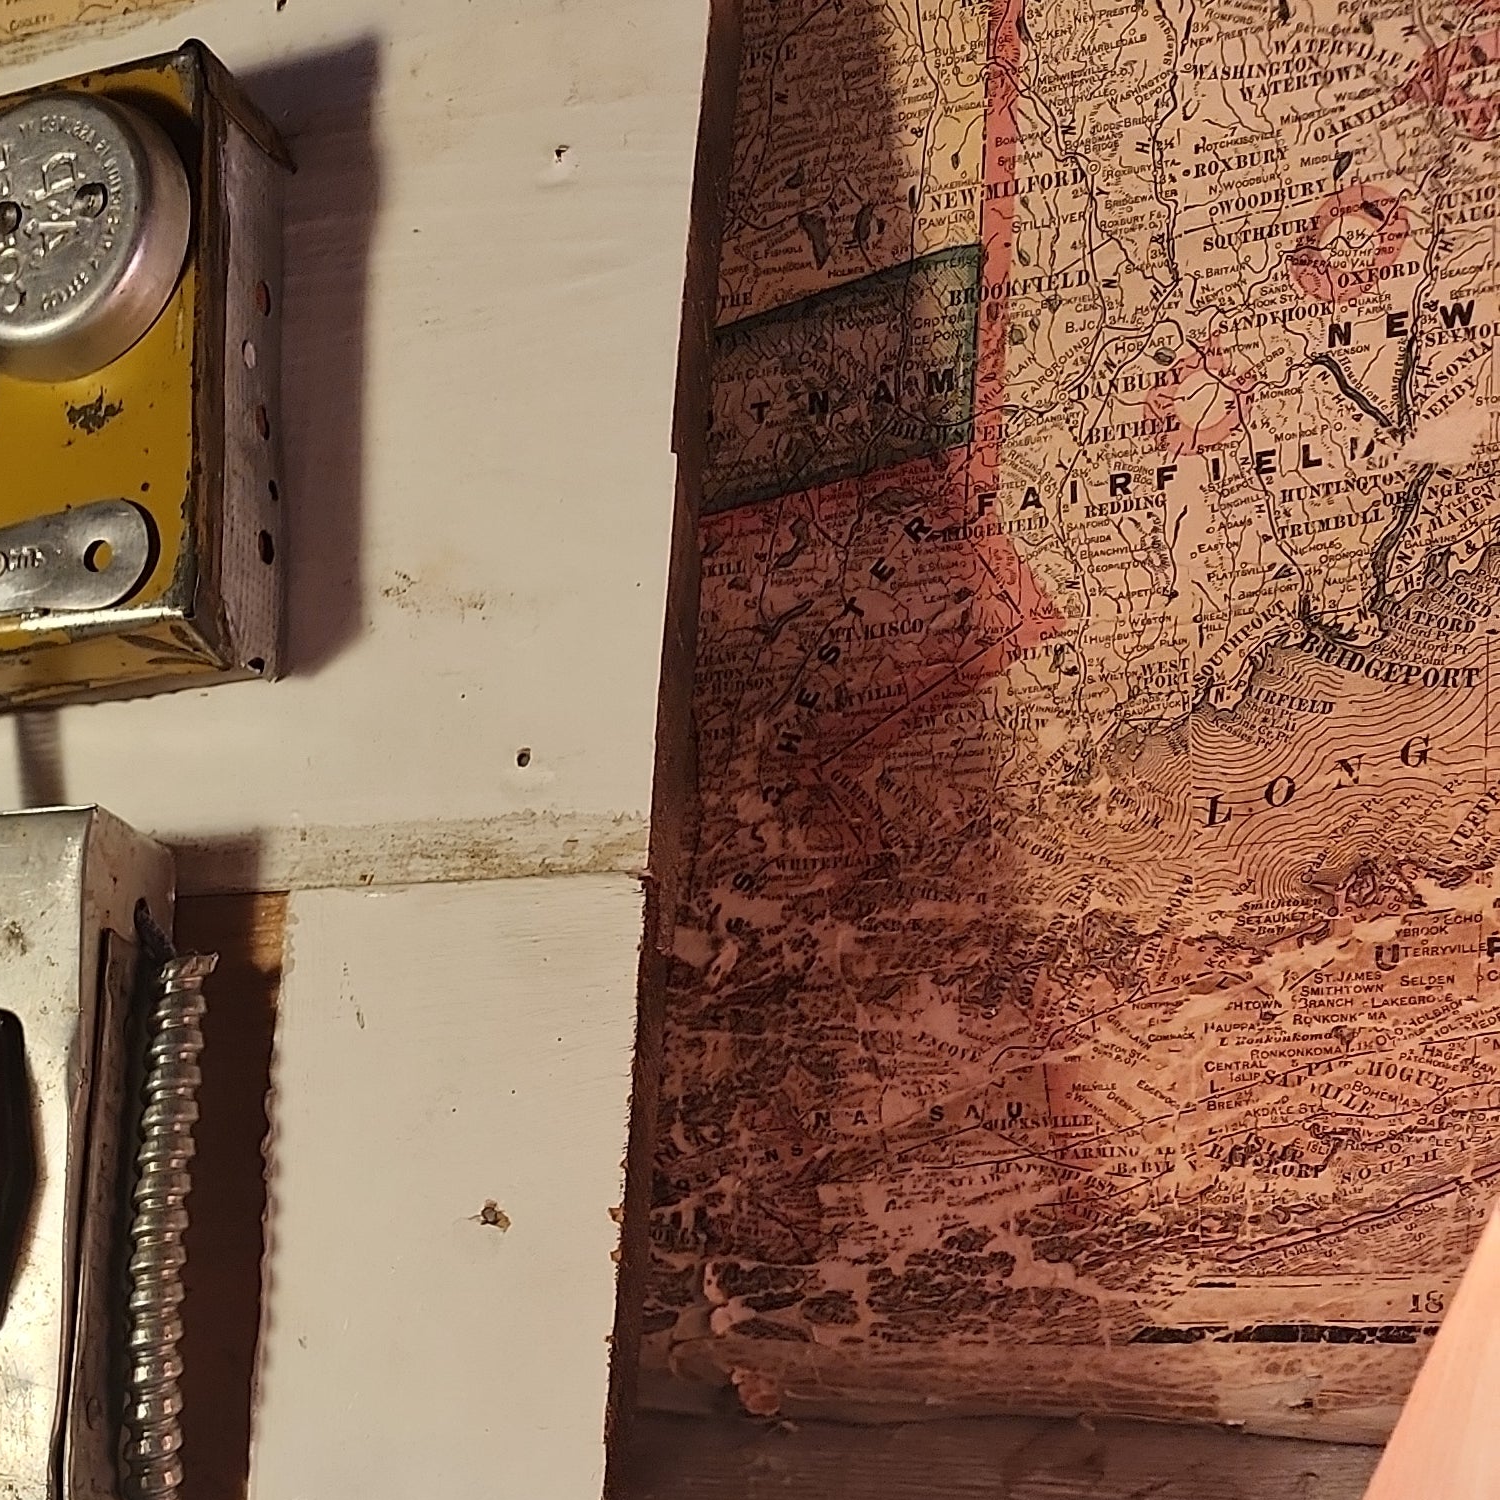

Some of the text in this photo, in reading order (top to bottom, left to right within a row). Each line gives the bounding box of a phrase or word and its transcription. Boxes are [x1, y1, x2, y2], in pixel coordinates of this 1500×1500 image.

[1192, 53, 1320, 82] WASHINGTON
[1240, 61, 1367, 102] WATERTOWN
[1135, 82, 1168, 105] DEPOT
[1193, 146, 1288, 179] ROXBURY
[930, 167, 1087, 212] NEW MILFORD
[1217, 177, 1328, 216] WOODBURY
[918, 211, 976, 230] PAWLING
[1203, 215, 1322, 252] SOUTHBURY
[1337, 260, 1420, 289] OXFORD
[1348, 293, 1392, 308] QUAKER
[1069, 366, 1184, 400] DANBURY
[1087, 414, 1181, 446] BETHEL
[1280, 471, 1408, 504] HUNTINGTON
[1084, 492, 1167, 518] REDDING
[1277, 508, 1385, 540] TRUMBULL
[1198, 540, 1239, 554] EASTON
[1202, 622, 1225, 633] HILL
[1194, 600, 1288, 686] SOUTHPORT
[1140, 658, 1191, 689] WEST PORT
[1300, 632, 1480, 688] BRIDGEPORT
[1233, 677, 1335, 716] FAIRFIELD
[1202, 733, 1434, 829] LONG
[1444, 913, 1484, 926] ECHO
[1401, 942, 1488, 959] TERRYVILLE
[1301, 984, 1385, 997] SMITHTOWN
[1338, 970, 1383, 983] JAMES
[1400, 973, 1456, 987] SELDEN
[1204, 1060, 1268, 1073] CENTRAL
[1251, 1046, 1341, 1060] RONKONKOMA
[1341, 1150, 1439, 1184] SOUTH
